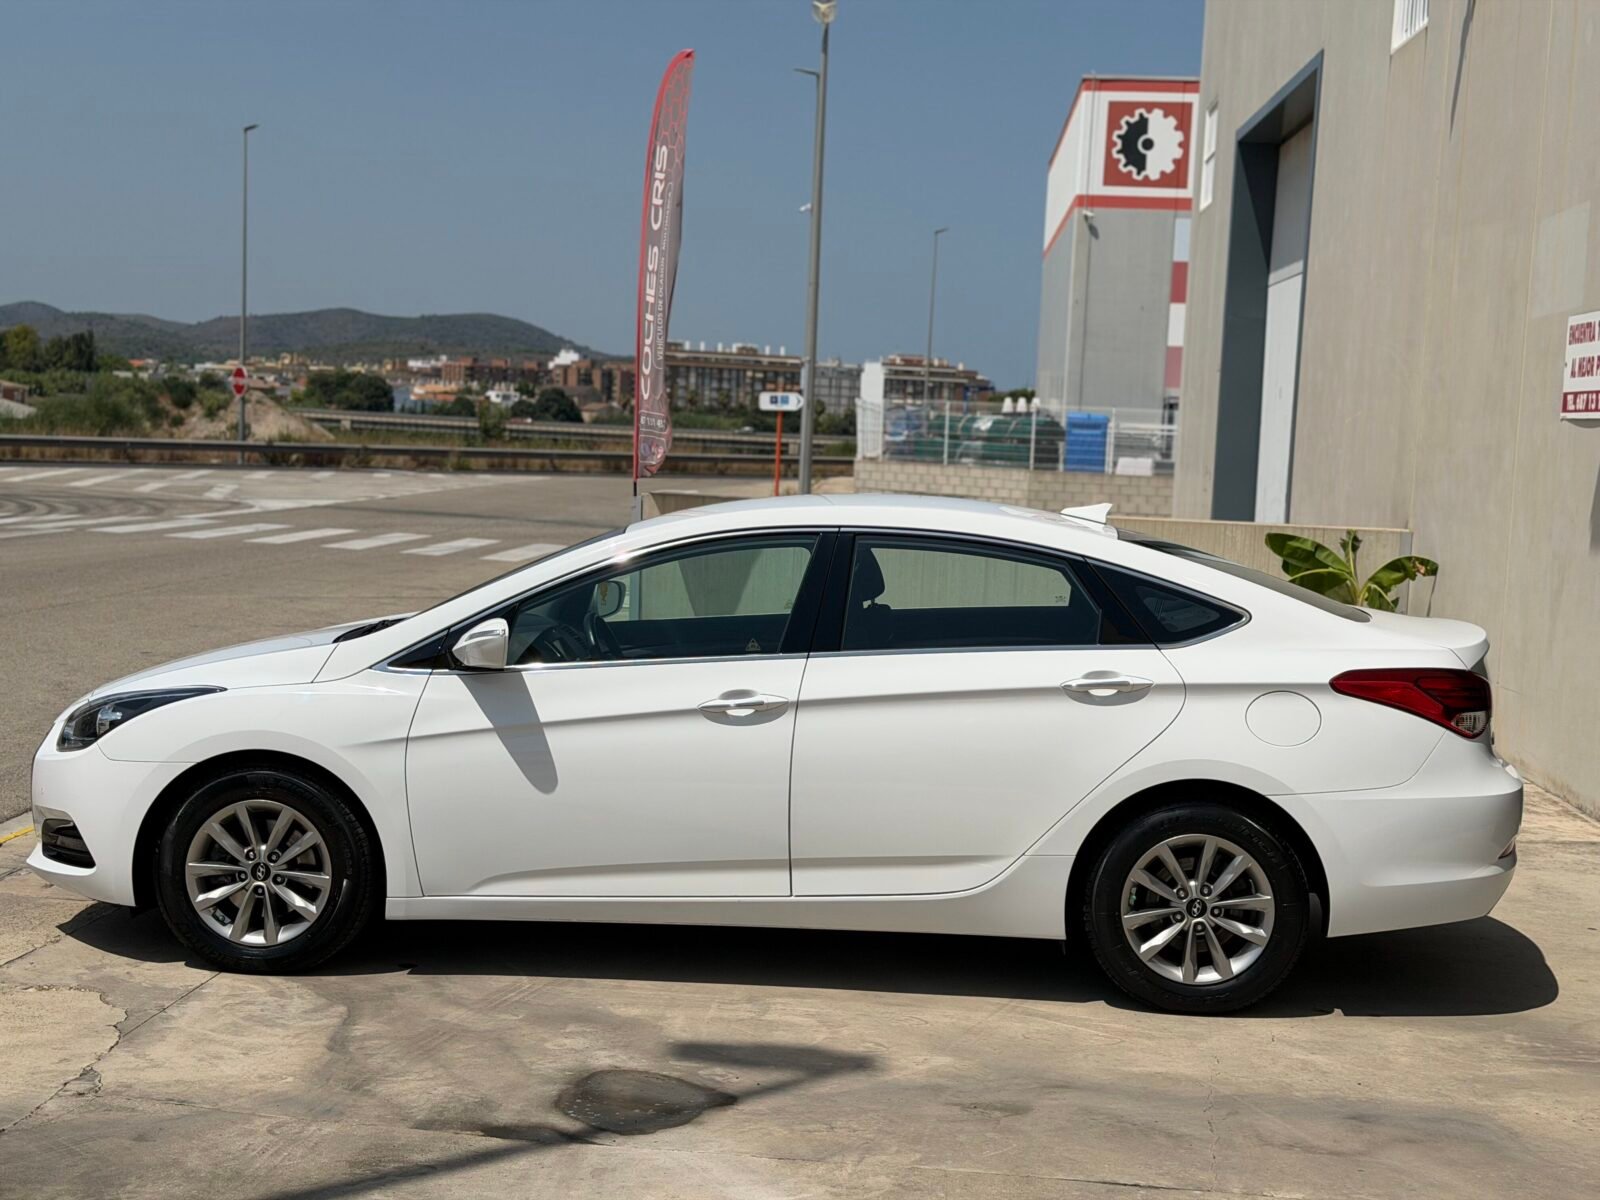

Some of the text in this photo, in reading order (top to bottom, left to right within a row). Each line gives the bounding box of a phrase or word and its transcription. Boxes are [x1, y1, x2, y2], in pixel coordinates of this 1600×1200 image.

[641, 145, 668, 400] COCHES CRIS
[658, 299, 663, 311] DE
[1569, 321, 1596, 345] ENCUENTRA
[1577, 356, 1595, 378] MEJOR
